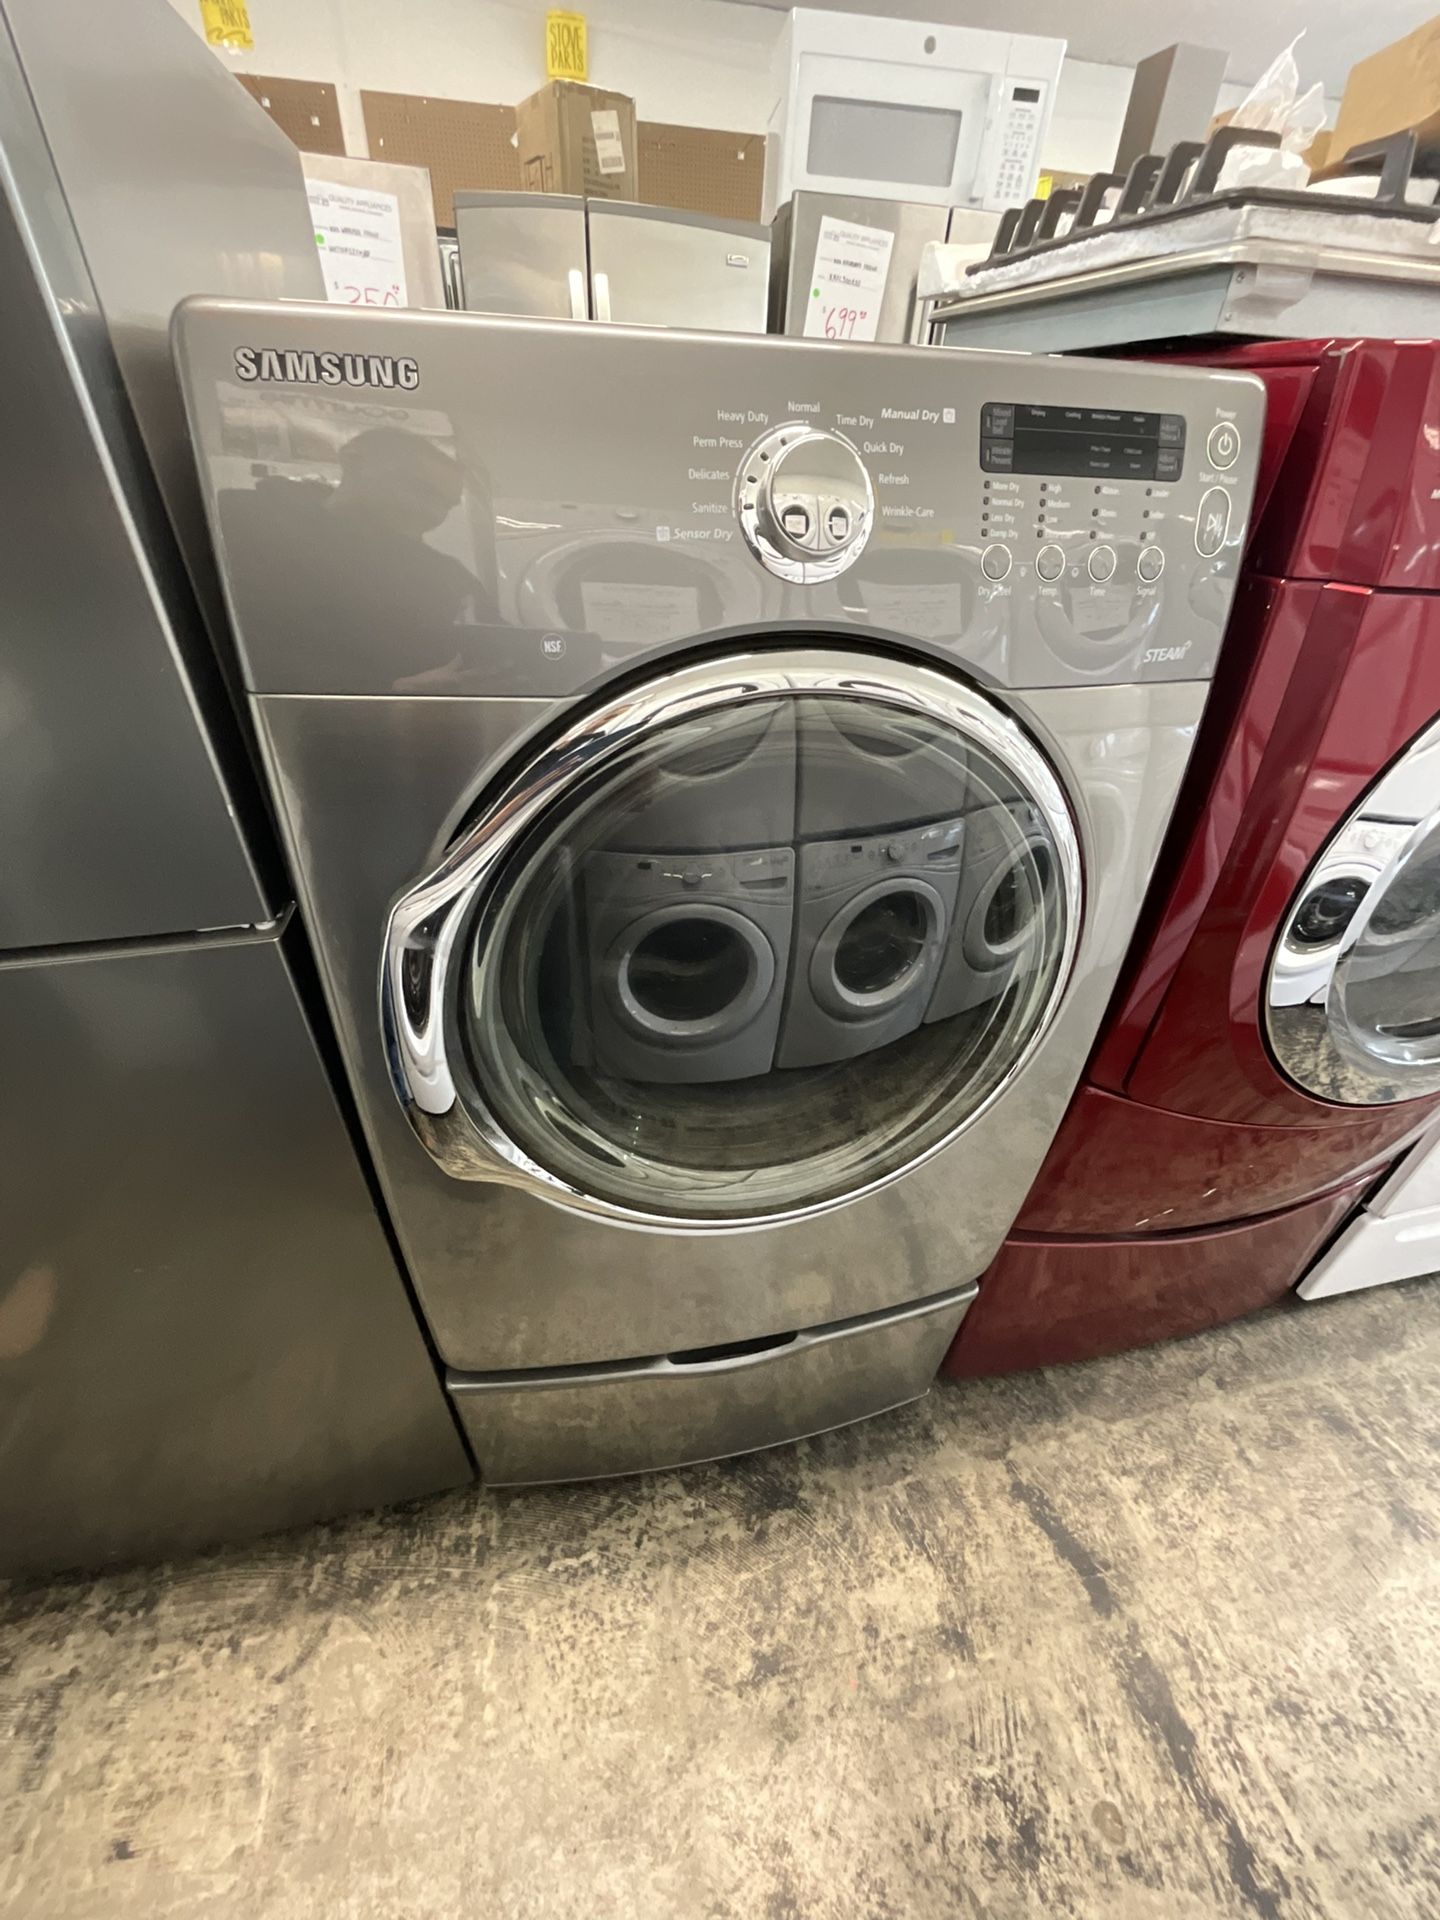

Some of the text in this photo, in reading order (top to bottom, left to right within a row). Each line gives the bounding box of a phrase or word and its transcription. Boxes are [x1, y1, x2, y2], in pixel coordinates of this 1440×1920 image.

[549, 24, 583, 51] STOVE
[551, 48, 584, 73] PARTS
[825, 307, 857, 340] 699
[234, 346, 420, 391] SAMSUNG
[787, 401, 820, 413] Normal
[717, 410, 769, 426] Heavy Duty
[836, 414, 874, 430] Time Dry
[881, 408, 940, 424] Manual Dry
[693, 436, 744, 449] Perm Press
[863, 441, 904, 457] Quick Dry
[687, 467, 730, 481] Delicates
[879, 472, 910, 485] Refresh
[1009, 482, 1020, 493] Dry
[692, 502, 728, 514] Sanitize
[1014, 498, 1025, 509] Dry
[882, 505, 935, 518] Wrinkle-Care
[1004, 513, 1015, 525] Dry
[673, 528, 734, 542] Sensor Dry
[544, 640, 561, 653] NSF
[1143, 646, 1186, 663] STEAM
